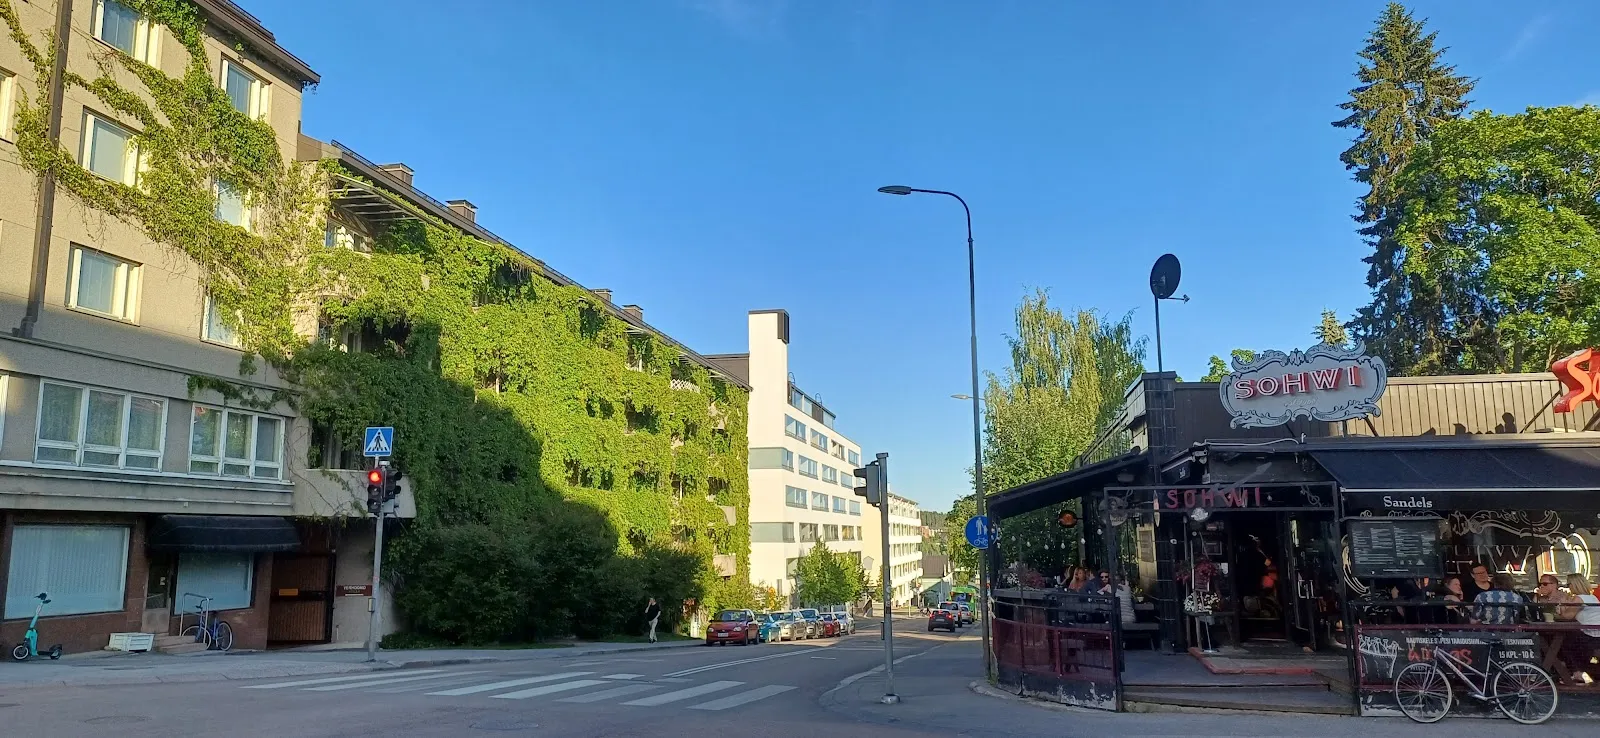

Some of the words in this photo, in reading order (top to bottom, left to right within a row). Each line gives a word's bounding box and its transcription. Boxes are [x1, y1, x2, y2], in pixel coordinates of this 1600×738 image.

[1234, 365, 1361, 401] SOHWI
[1165, 487, 1260, 509] SOHWI
[1383, 495, 1433, 508] Sandels
[1498, 650, 1506, 659] 15
[1506, 650, 1518, 659] KPL
[1522, 650, 1530, 659] 10
